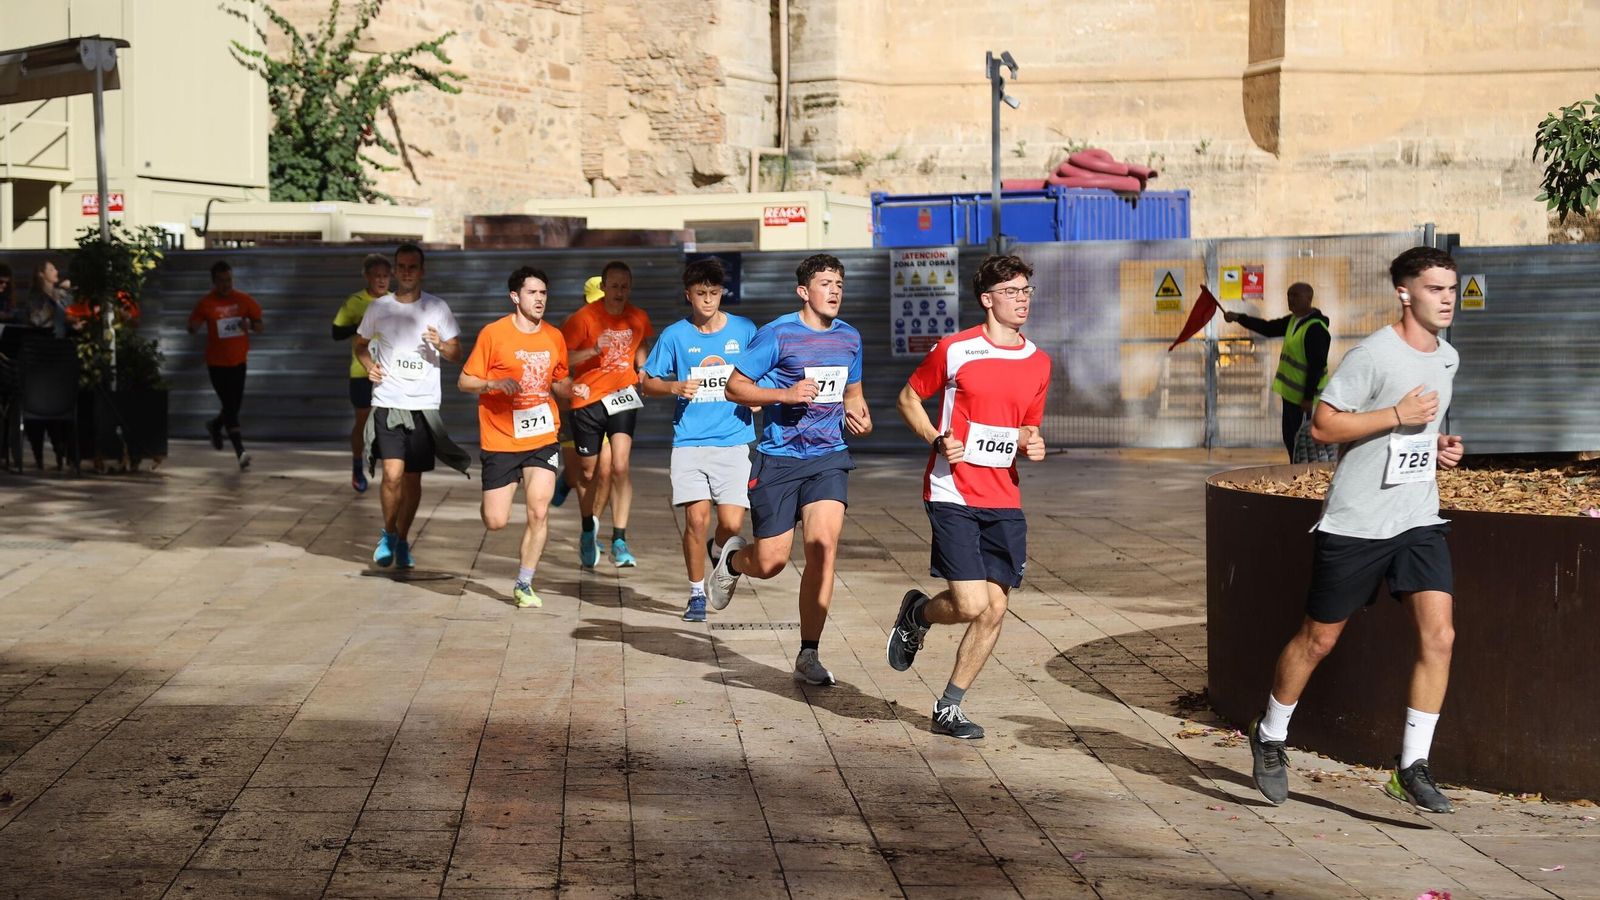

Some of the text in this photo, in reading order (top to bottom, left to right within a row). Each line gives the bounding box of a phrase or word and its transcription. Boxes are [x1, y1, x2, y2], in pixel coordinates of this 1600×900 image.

[83, 194, 123, 206] RESA
[765, 207, 806, 218] REMSA
[396, 359, 424, 370] 1063
[699, 376, 727, 388] 466
[817, 380, 836, 392] 71
[611, 394, 634, 406] 460
[521, 415, 546, 429] 371
[976, 439, 1014, 454] 1046
[1398, 452, 1430, 469] 728
